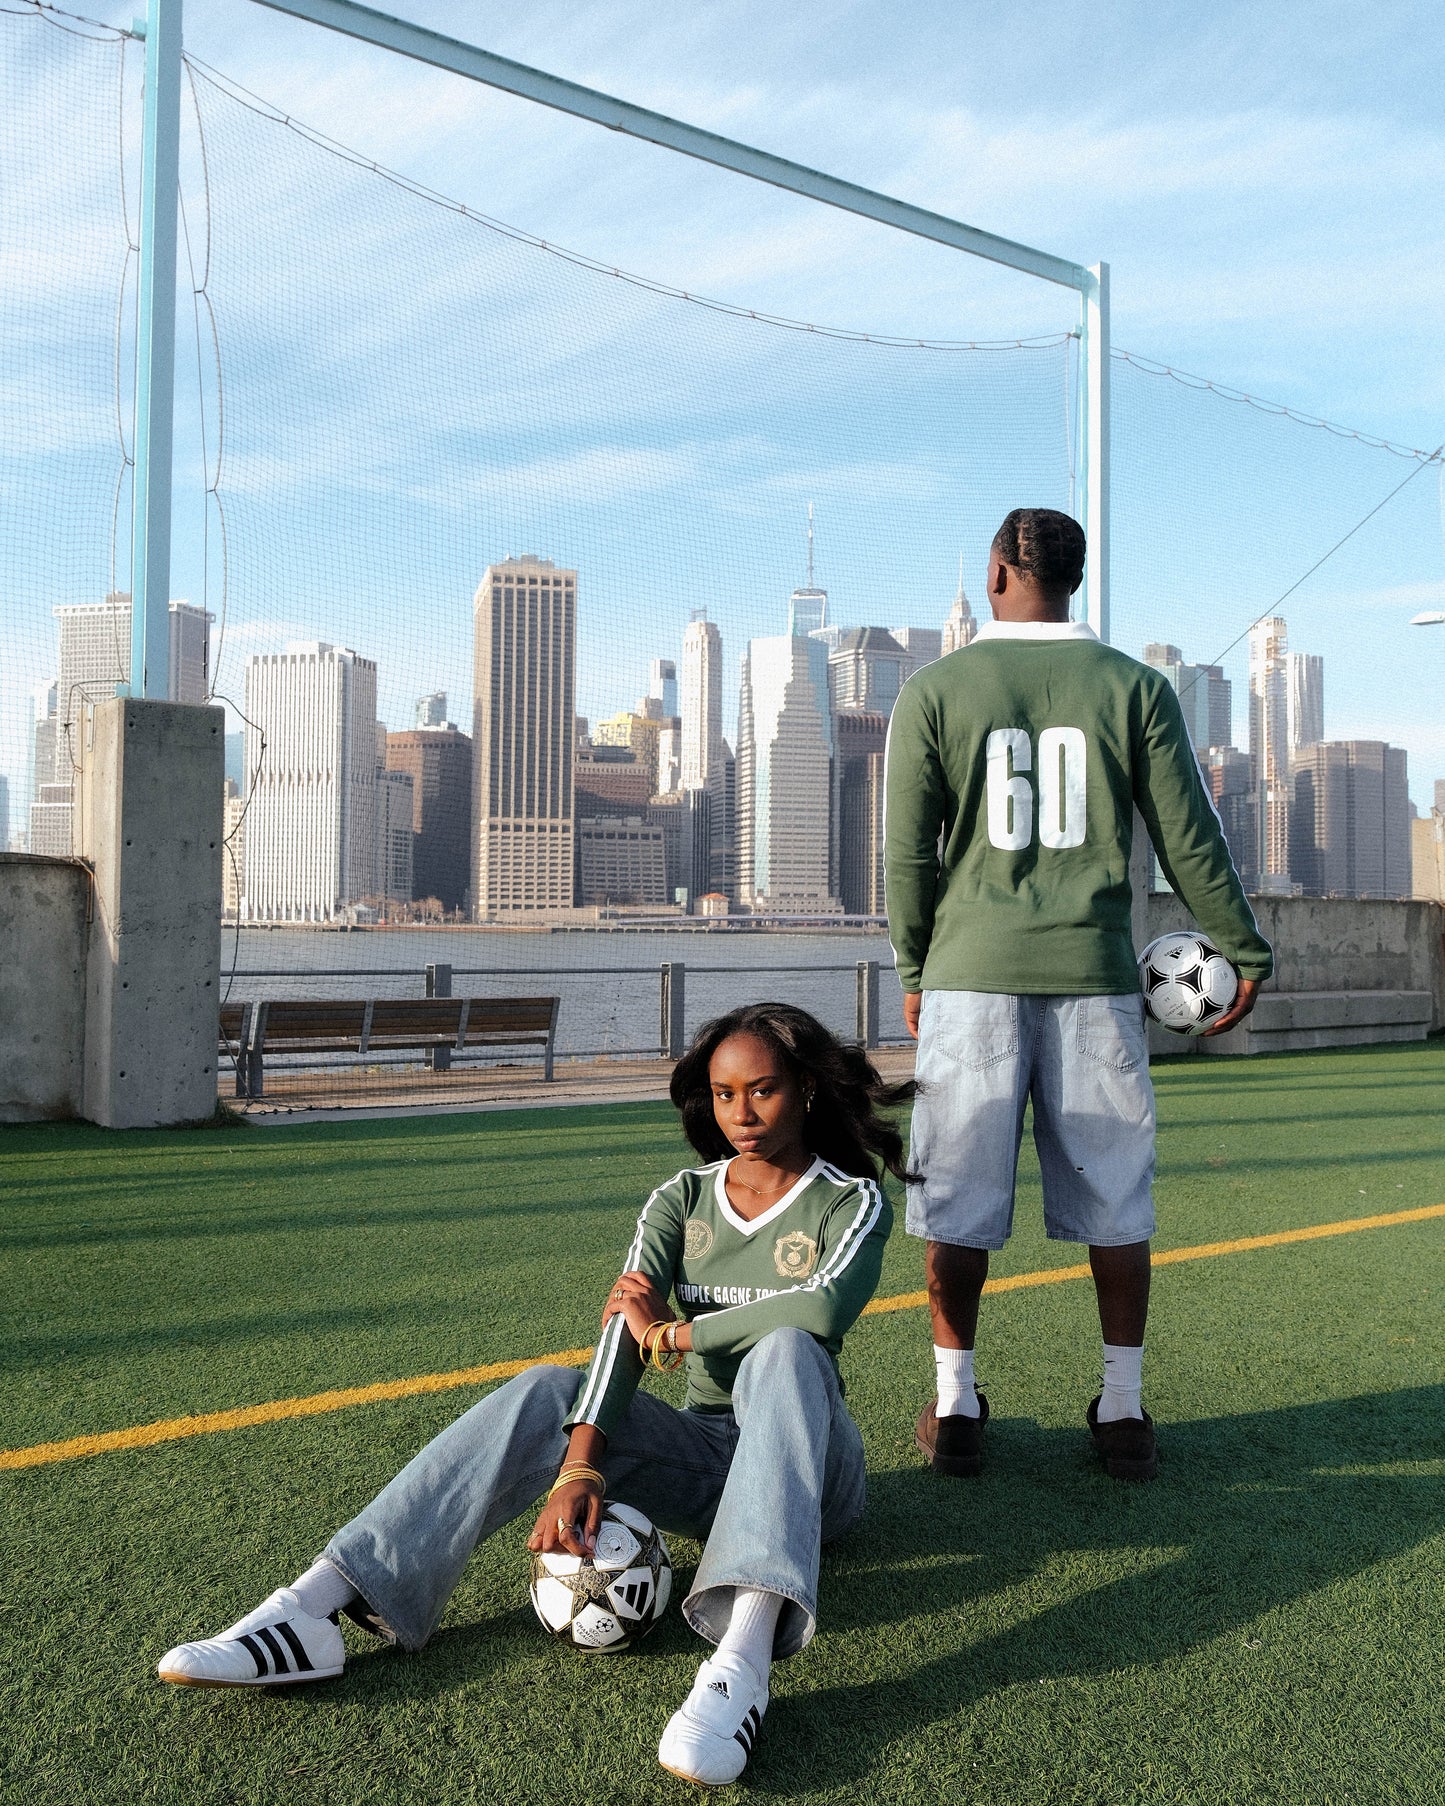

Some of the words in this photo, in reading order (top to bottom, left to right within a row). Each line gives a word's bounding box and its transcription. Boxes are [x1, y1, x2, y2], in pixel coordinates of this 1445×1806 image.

[986, 727, 1087, 851] 60
[677, 1283, 710, 1303] PEUPLE
[714, 1286, 751, 1304] GAGNE
[707, 1684, 730, 1700] adidas
